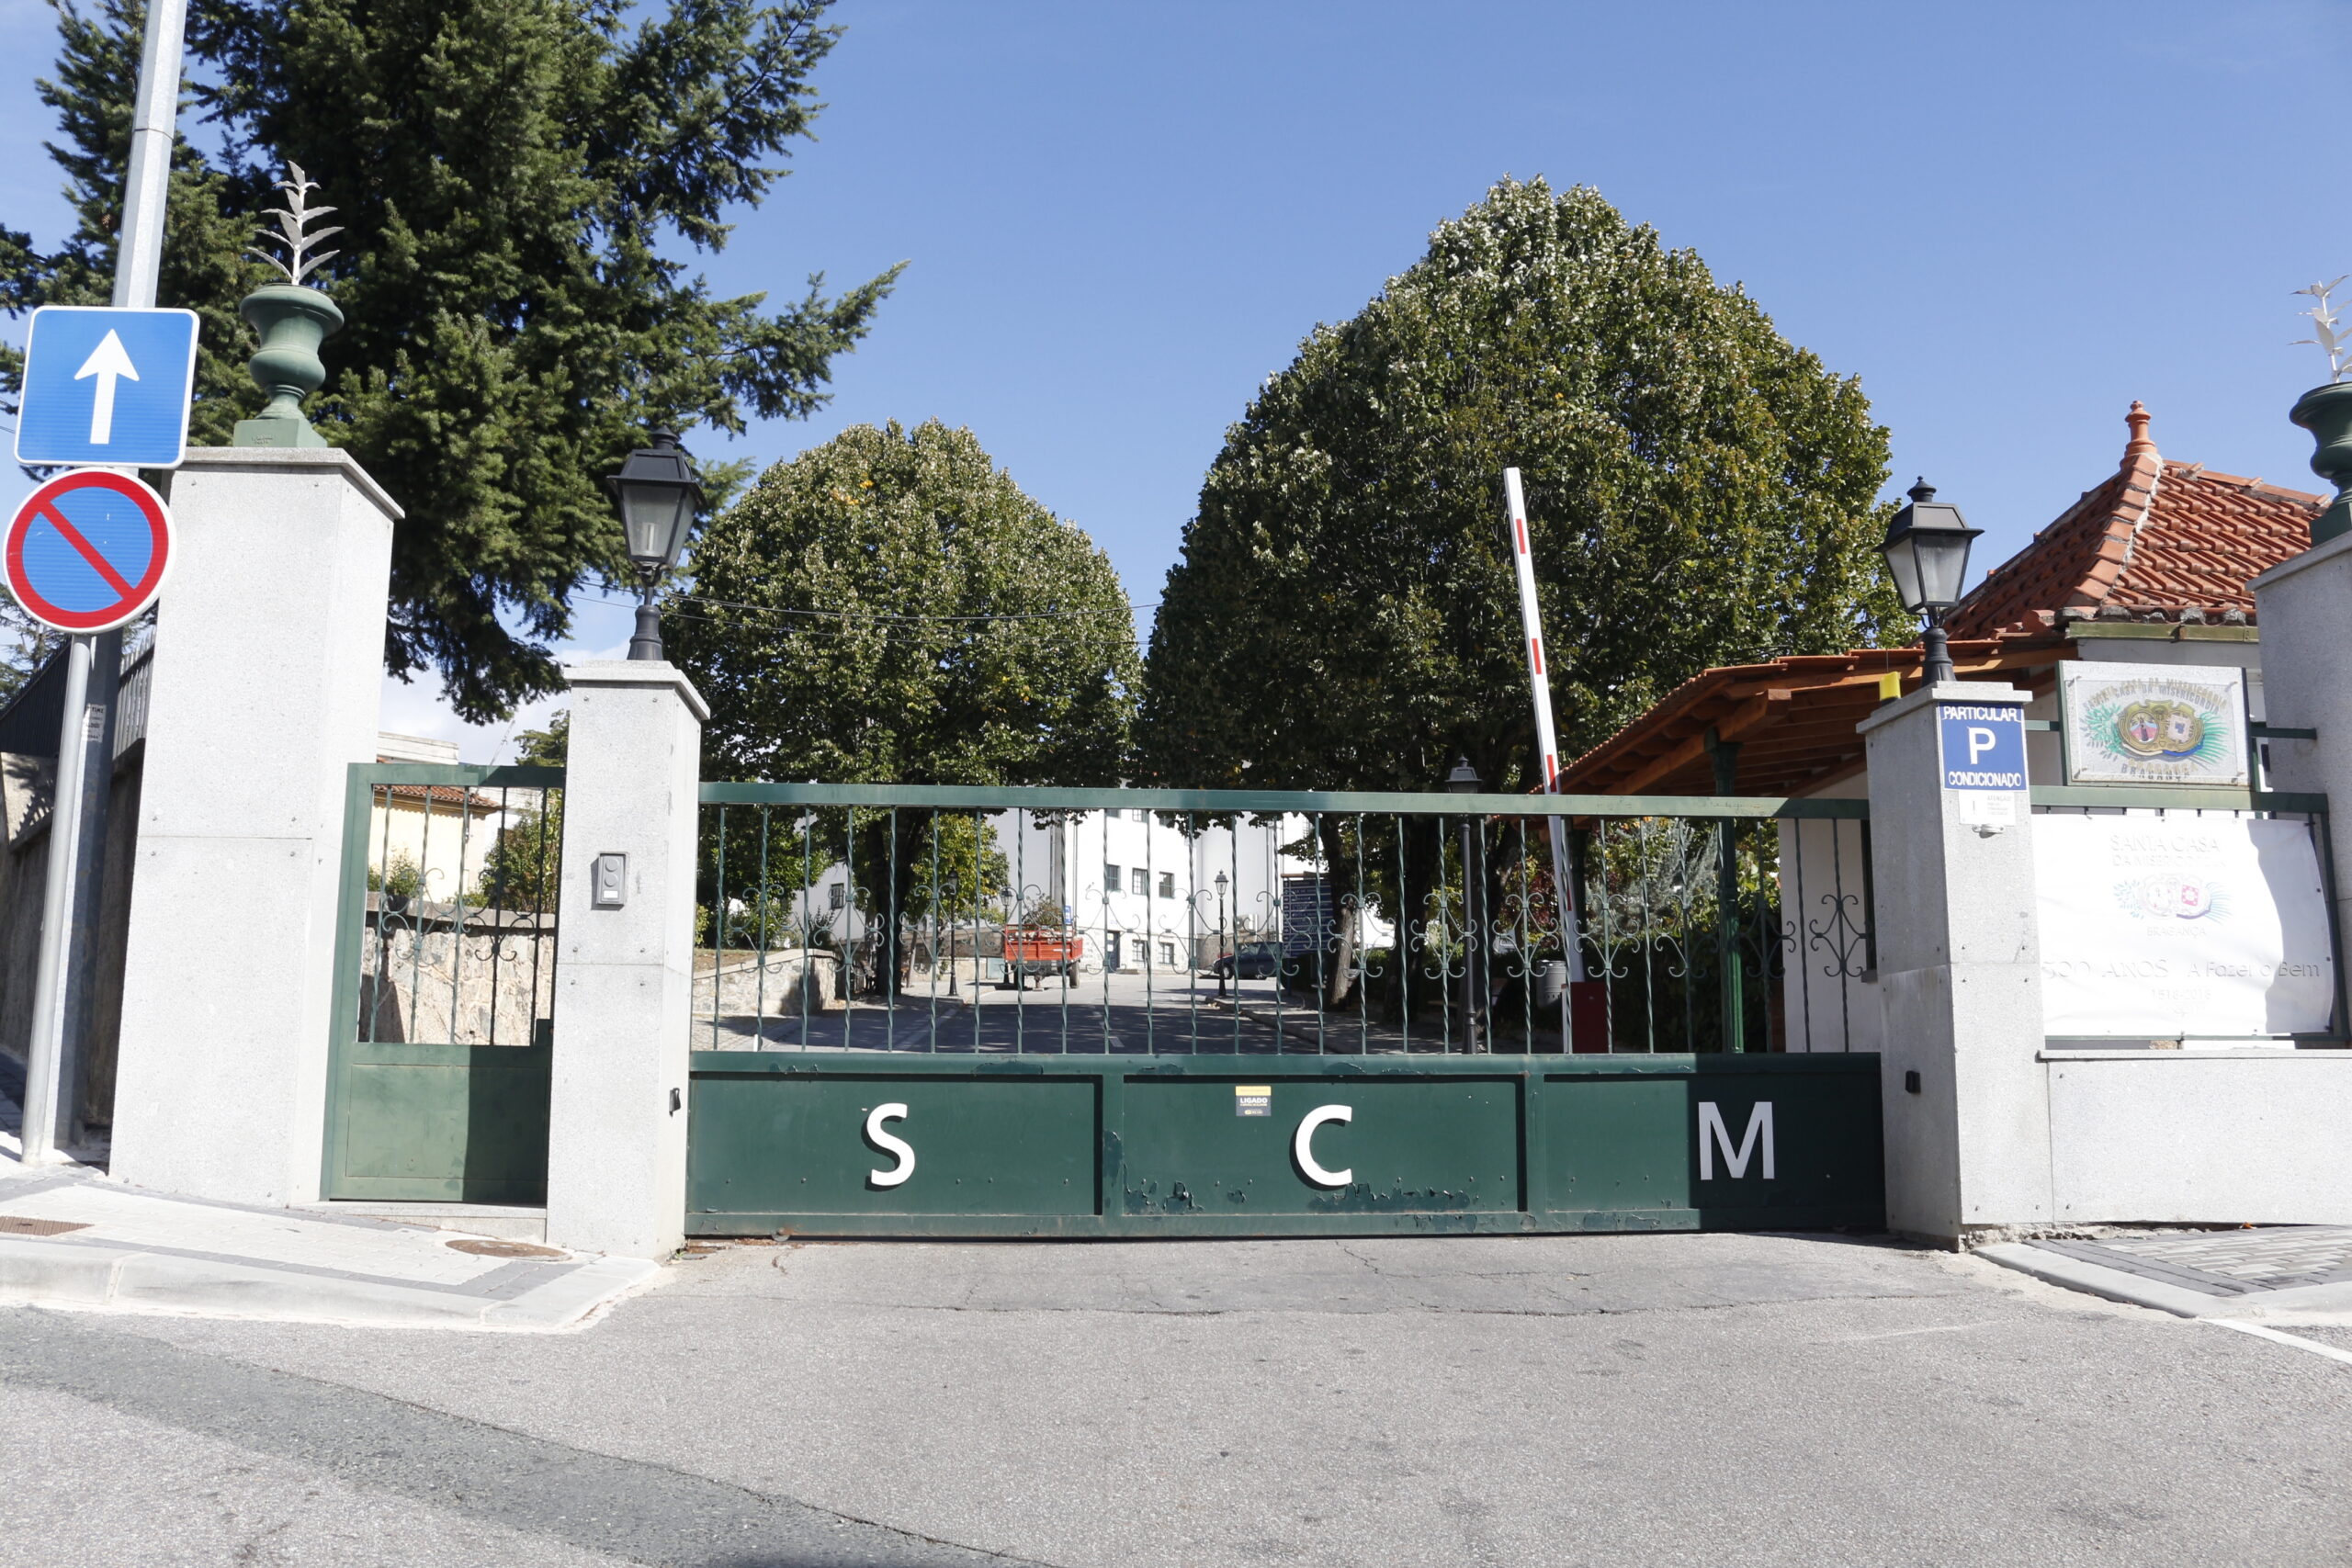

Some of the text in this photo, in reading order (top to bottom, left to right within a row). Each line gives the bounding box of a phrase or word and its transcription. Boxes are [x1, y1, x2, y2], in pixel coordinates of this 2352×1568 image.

[1942, 706, 2021, 722] PARTICULAR
[1967, 727, 1996, 765] P
[1948, 771, 2021, 788] CONDICIONADO
[2109, 834, 2221, 852] SANTA CASA
[2146, 925, 2207, 939] BRAGANÇA
[2041, 960, 2091, 979] 500
[2101, 958, 2169, 978] ANOS
[2187, 961, 2201, 977] A
[2278, 961, 2320, 977] Bem
[866, 1101, 1775, 1186] S C M
